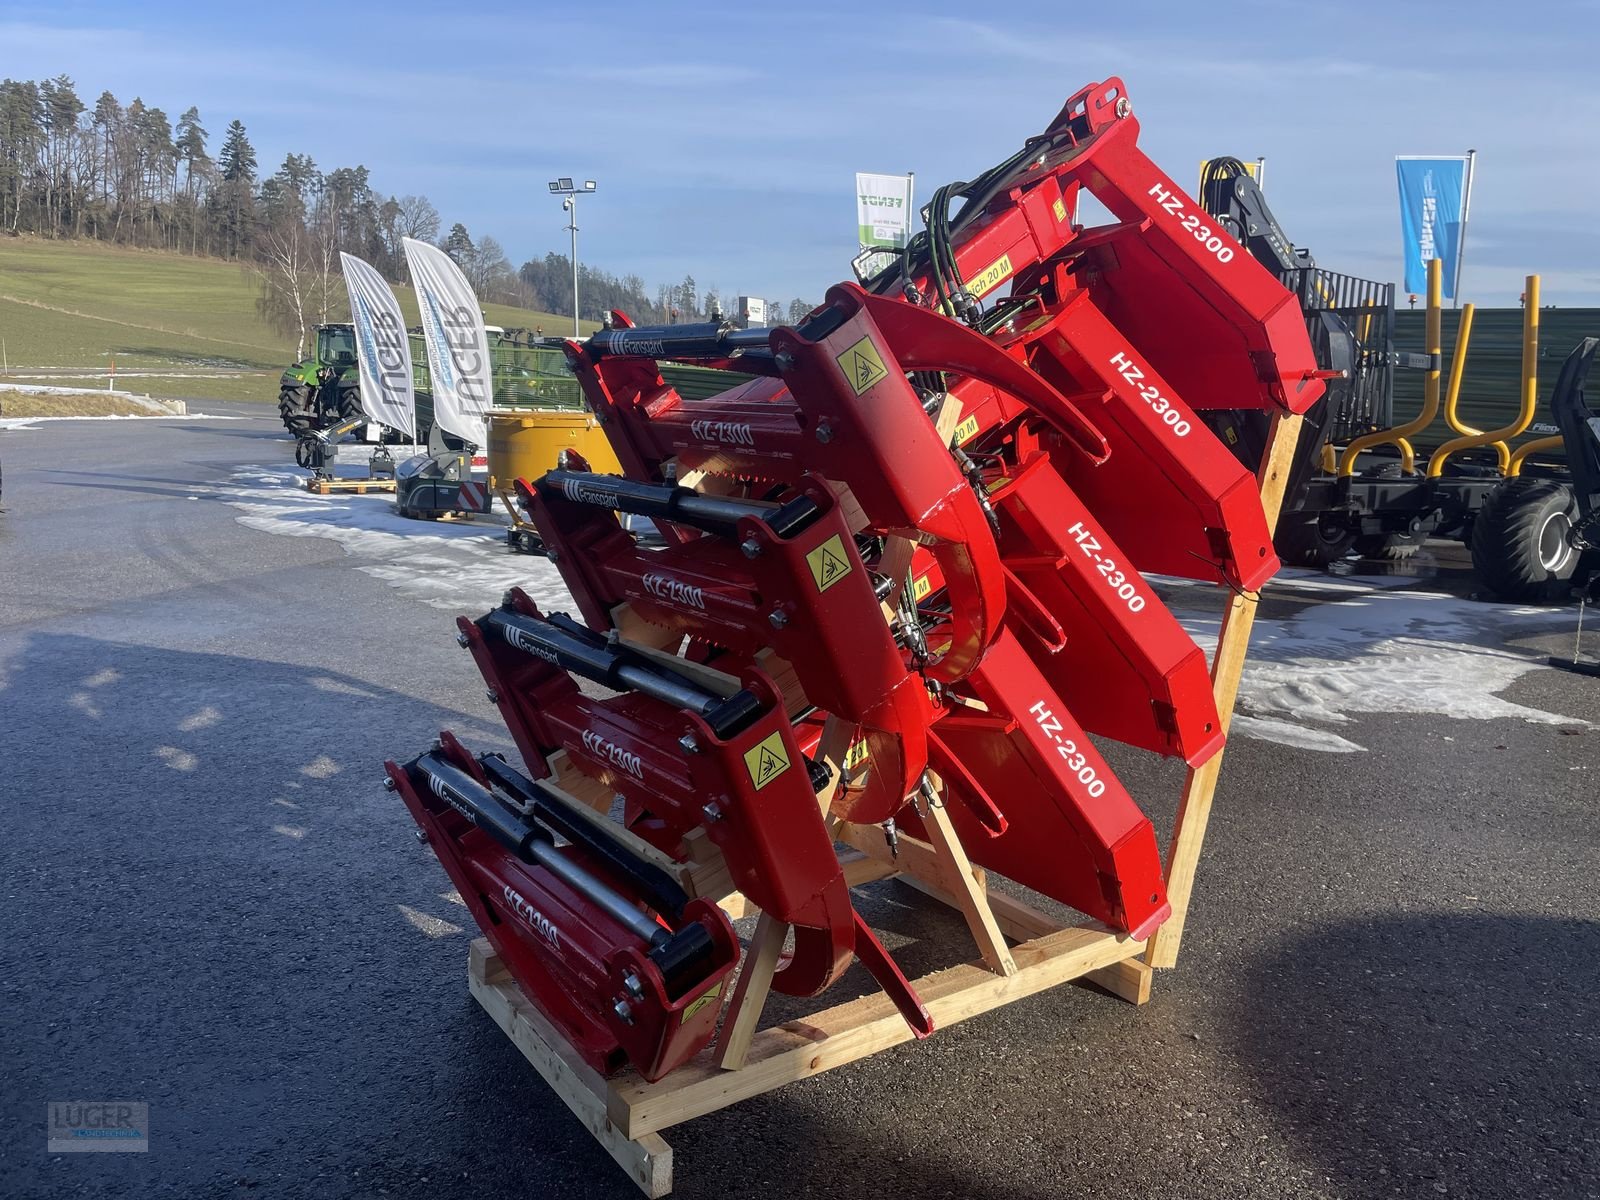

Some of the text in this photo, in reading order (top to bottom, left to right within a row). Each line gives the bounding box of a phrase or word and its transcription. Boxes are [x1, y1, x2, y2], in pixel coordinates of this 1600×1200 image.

[1147, 183, 1234, 263] HZ-2300
[987, 259, 1010, 284] 20 M
[1109, 351, 1191, 437] HZ-2300
[691, 420, 754, 445] HZ-2300
[966, 419, 976, 434] M
[1532, 422, 1560, 434] Flieg
[642, 573, 705, 609] HZ-2300
[1067, 521, 1146, 613] HZ-2300
[582, 729, 644, 779] HZ-2300
[1028, 700, 1106, 798] HZ-2300
[504, 886, 560, 950] HZ-2300
